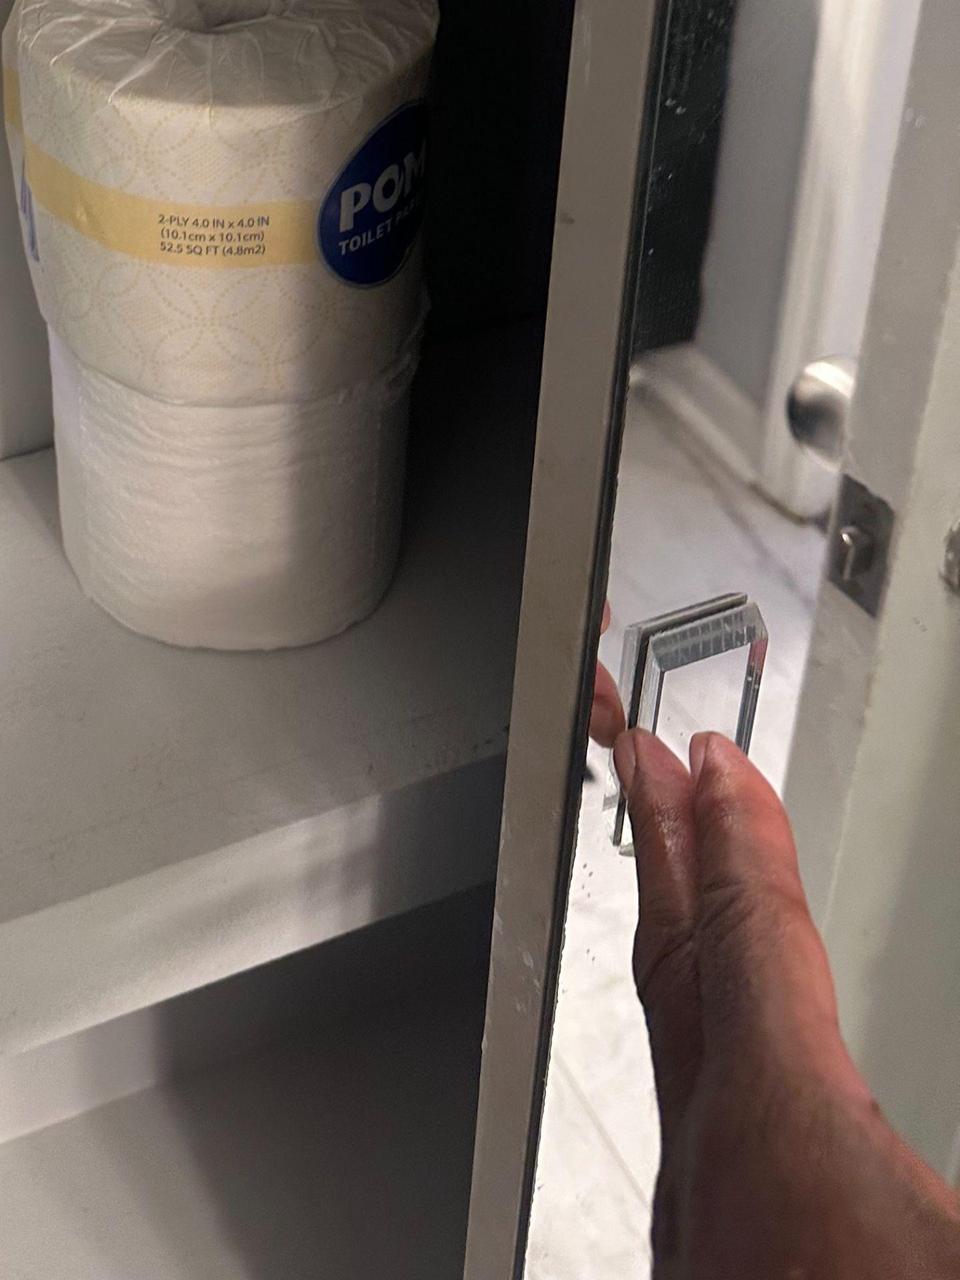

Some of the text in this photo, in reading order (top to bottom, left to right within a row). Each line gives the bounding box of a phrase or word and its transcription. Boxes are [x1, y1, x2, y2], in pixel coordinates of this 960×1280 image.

[158, 213, 270, 229] 2-PLY 4.0 IN x 4.0 IN
[160, 227, 265, 243] (10.1cm x 10.1cm)
[338, 217, 394, 257] TOILET
[160, 241, 184, 254] 52.5
[185, 244, 203, 256] SQ
[205, 244, 220, 256] FT
